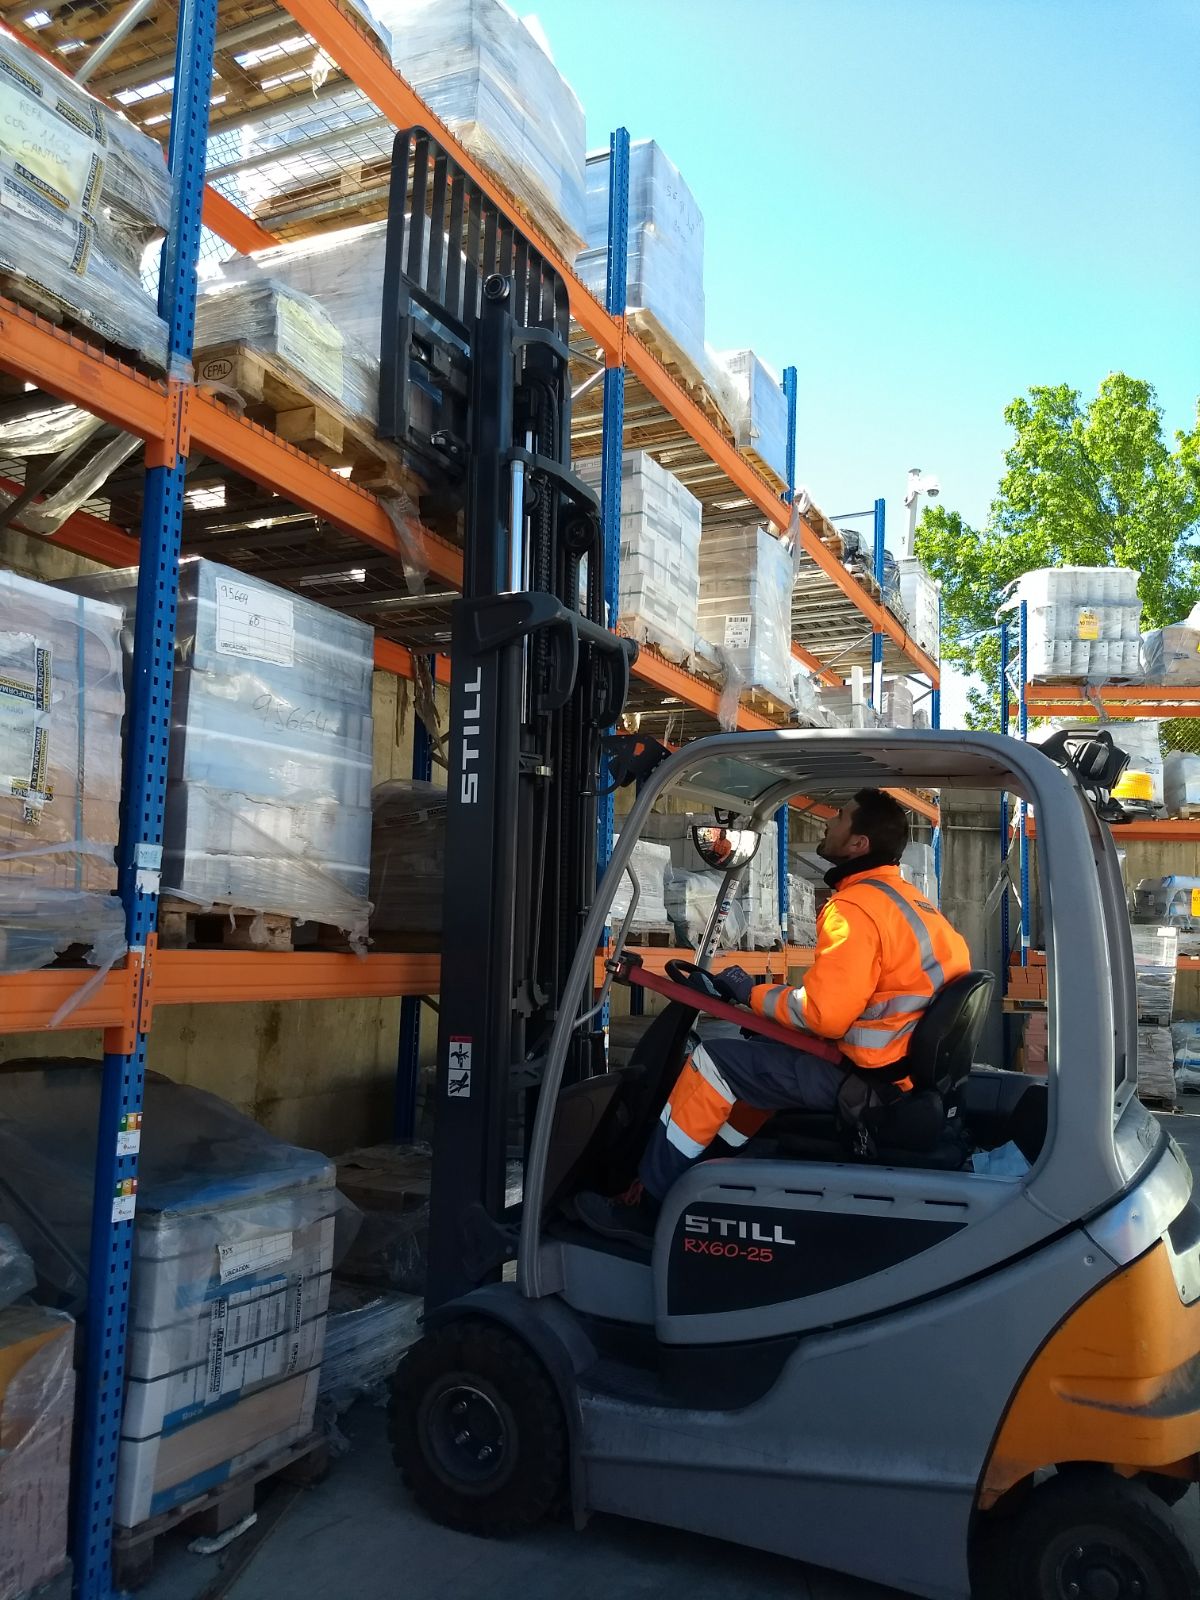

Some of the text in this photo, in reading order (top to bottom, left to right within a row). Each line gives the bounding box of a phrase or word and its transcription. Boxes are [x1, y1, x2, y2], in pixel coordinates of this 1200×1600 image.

[208, 363, 227, 378] EPAL
[36, 649, 44, 710] LA PLATAFORMA
[33, 727, 42, 779] PLATAFORMA
[461, 667, 481, 803] STILL
[684, 1237, 773, 1262] RX60-25
[685, 1214, 796, 1245] STILL
